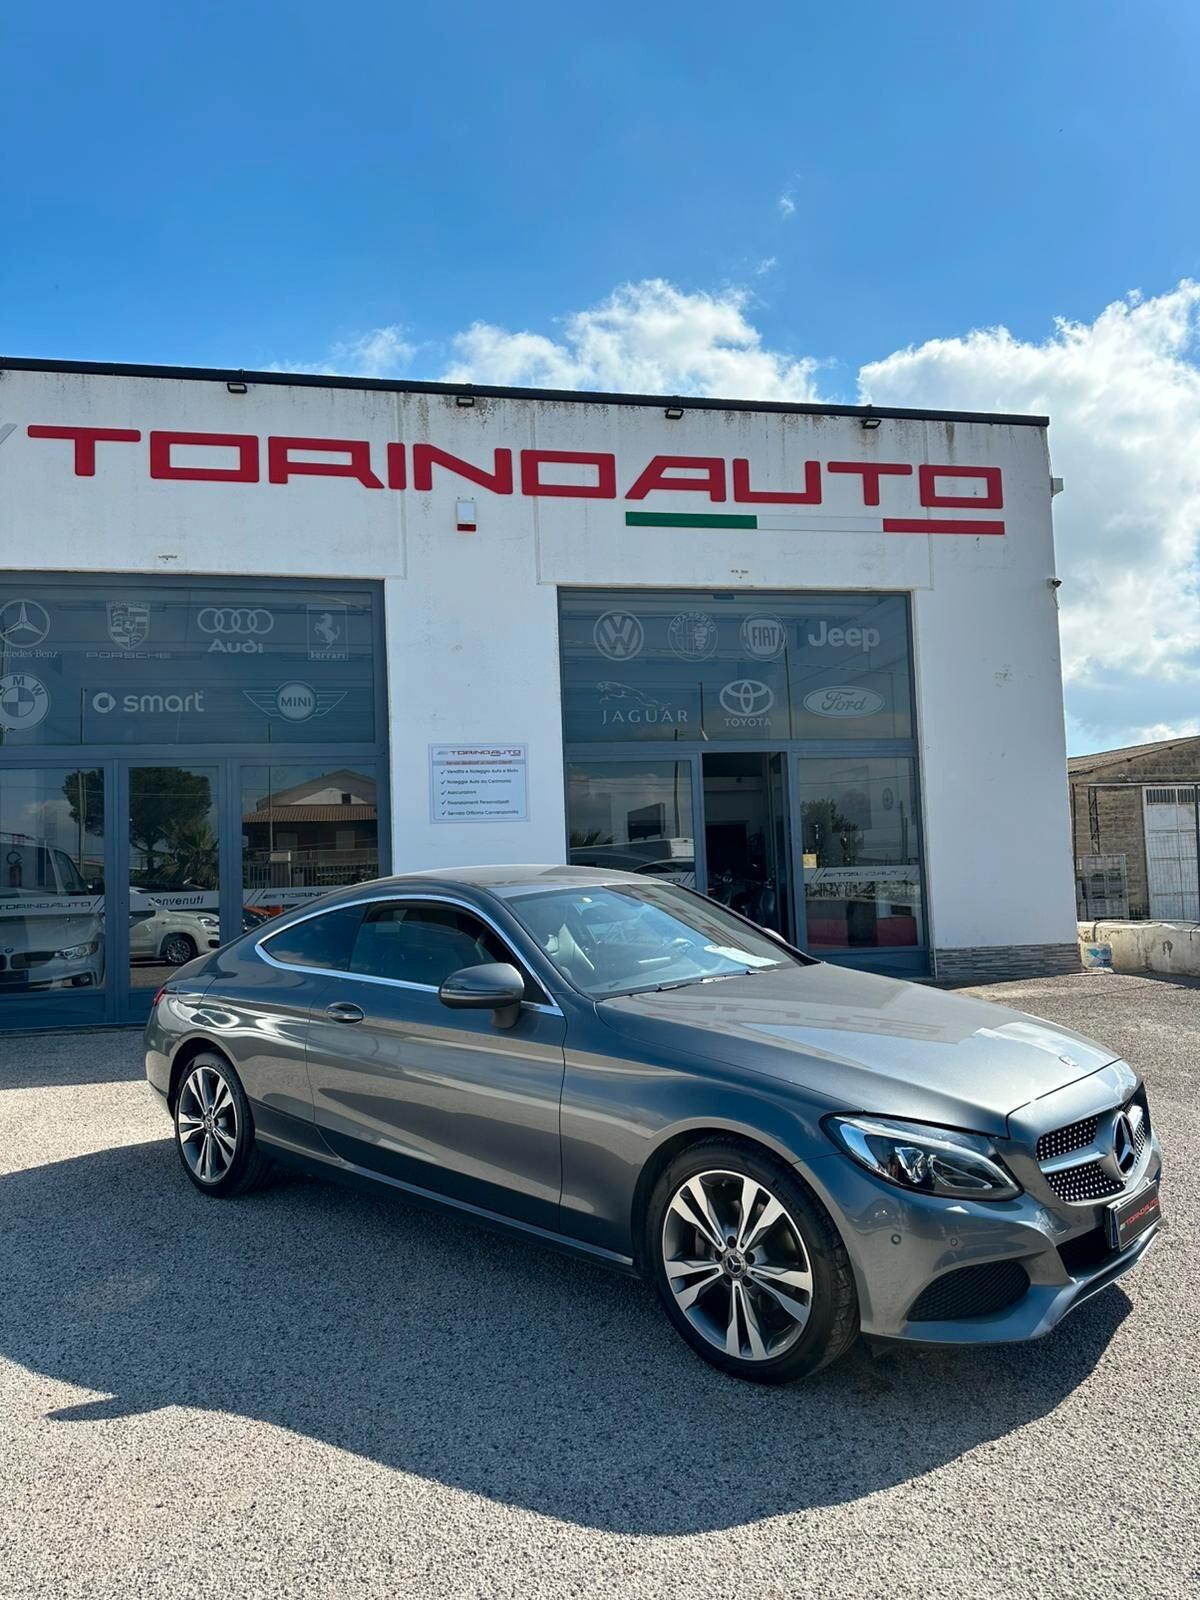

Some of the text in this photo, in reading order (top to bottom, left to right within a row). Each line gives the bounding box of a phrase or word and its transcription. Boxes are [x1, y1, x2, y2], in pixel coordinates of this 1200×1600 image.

[28, 424, 1004, 509] TORINOAUTO
[208, 639, 263, 653] Audi
[752, 627, 777, 647] FIAT
[808, 620, 881, 652] Jeep
[123, 691, 204, 712] smart
[280, 695, 312, 709] MINI
[821, 690, 866, 712] Ford
[602, 709, 688, 725] JAGUAR
[724, 717, 772, 727] TOYOTA
